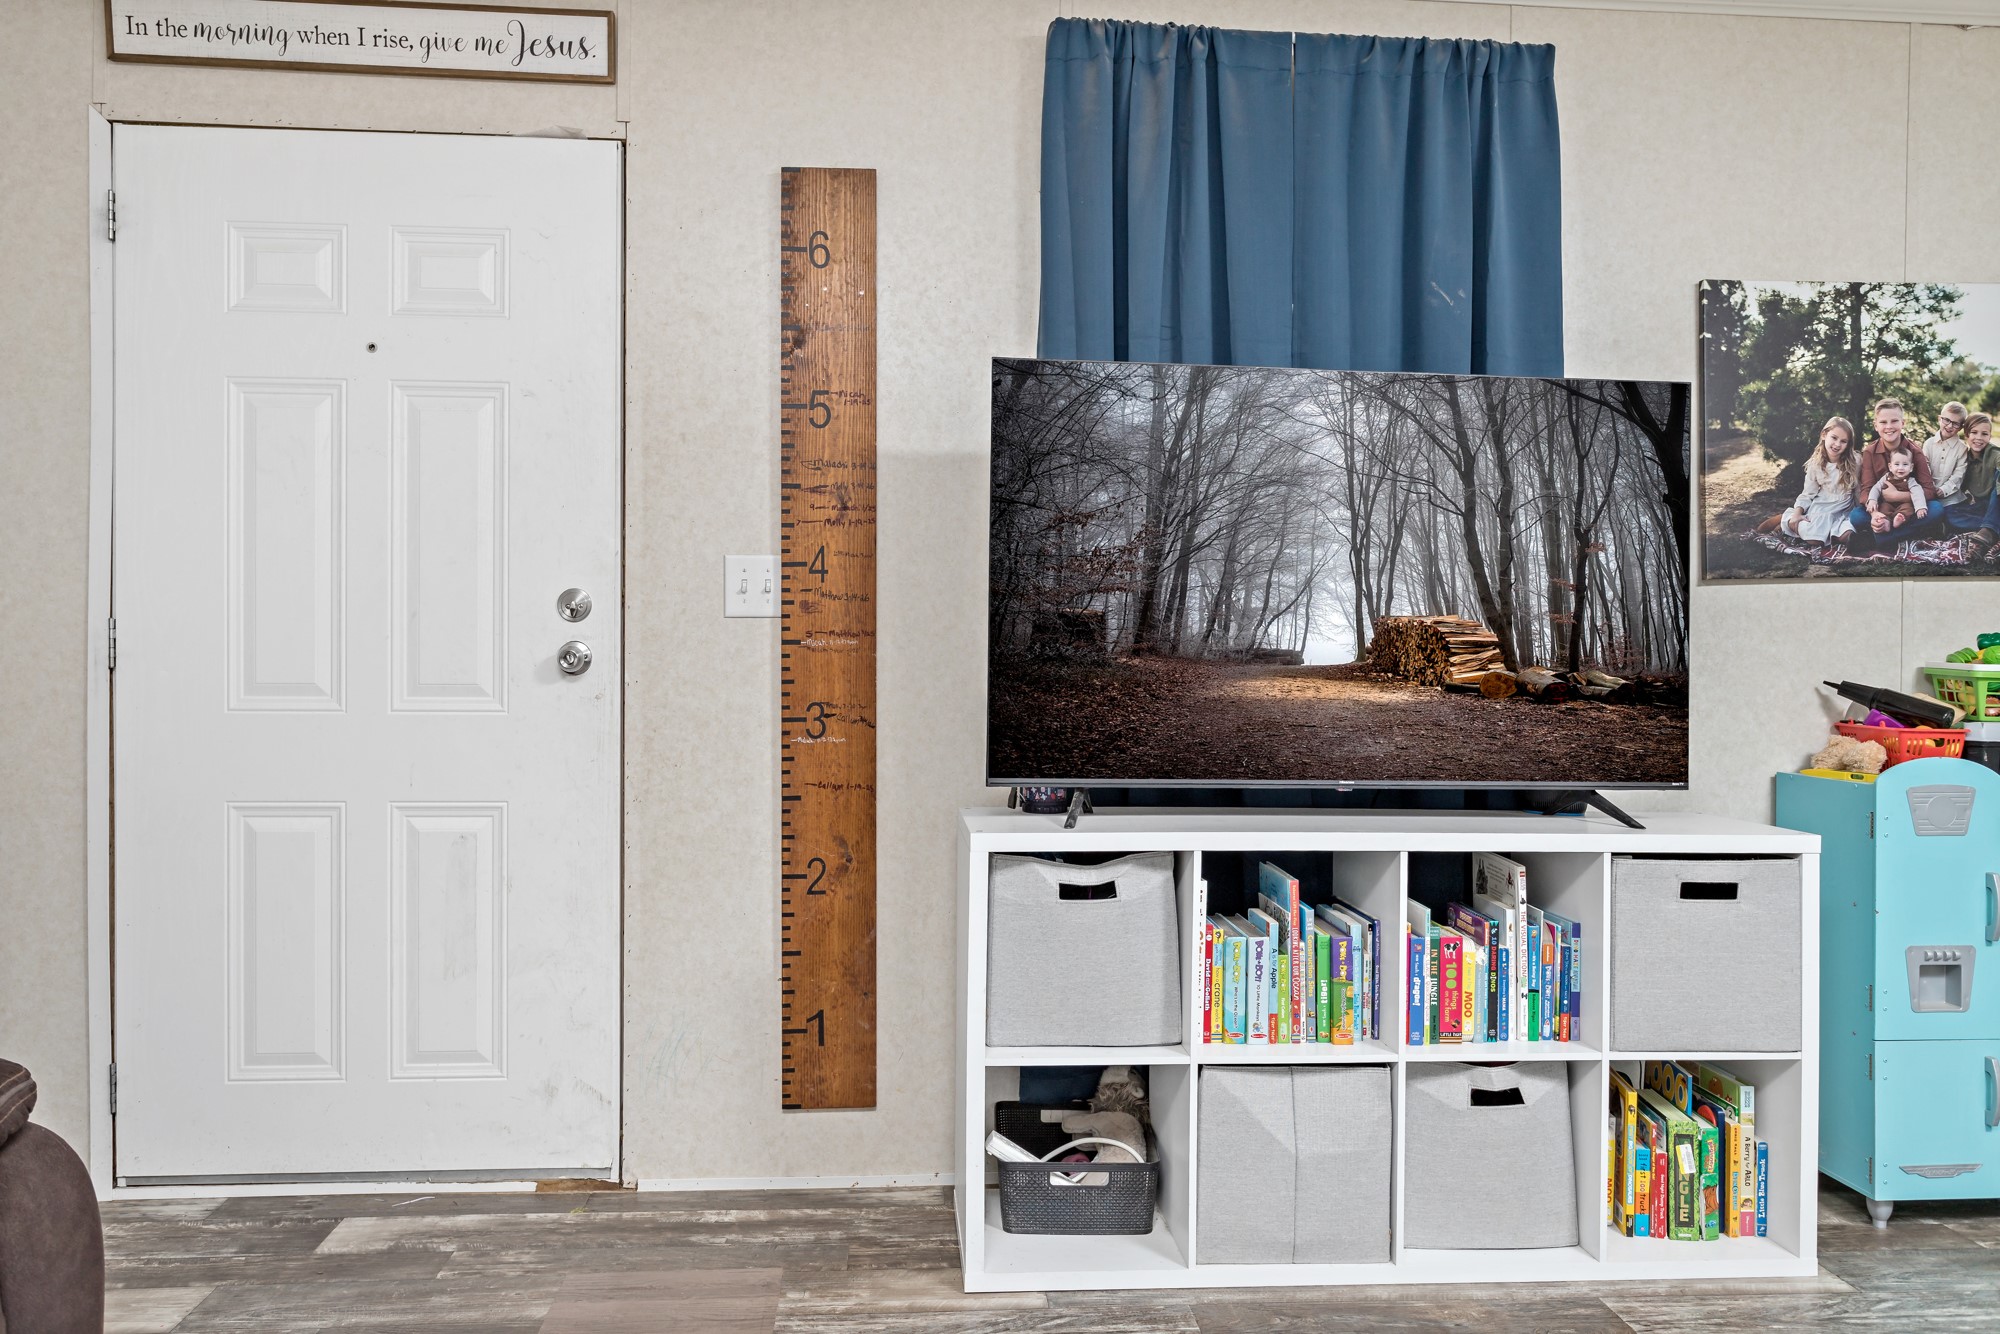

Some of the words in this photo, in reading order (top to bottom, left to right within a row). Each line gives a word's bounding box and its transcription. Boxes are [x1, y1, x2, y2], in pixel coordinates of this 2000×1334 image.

[125, 16, 149, 36] In
[156, 17, 188, 38] the
[193, 22, 294, 56] morning
[297, 27, 349, 46] when
[357, 28, 367, 47] I
[372, 30, 414, 51] rise,
[420, 34, 468, 64] give
[474, 36, 506, 54] me
[507, 19, 598, 66] Jesus.
[809, 231, 830, 268] 6
[809, 390, 831, 428] 5
[824, 518, 846, 529] Molly
[809, 545, 829, 583] 4
[806, 702, 826, 739] 3
[807, 857, 827, 895] 2
[1431, 949, 1438, 958] IN
[1491, 937, 1497, 945] 10
[1446, 962, 1457, 989] 100
[1464, 991, 1472, 1018] MOO
[806, 1009, 825, 1047] 1
[1744, 1170, 1752, 1187] ARLO
[1758, 1181, 1766, 1196] Blue
[1679, 1171, 1690, 1222] NGLE
[1758, 1198, 1766, 1218] Little
